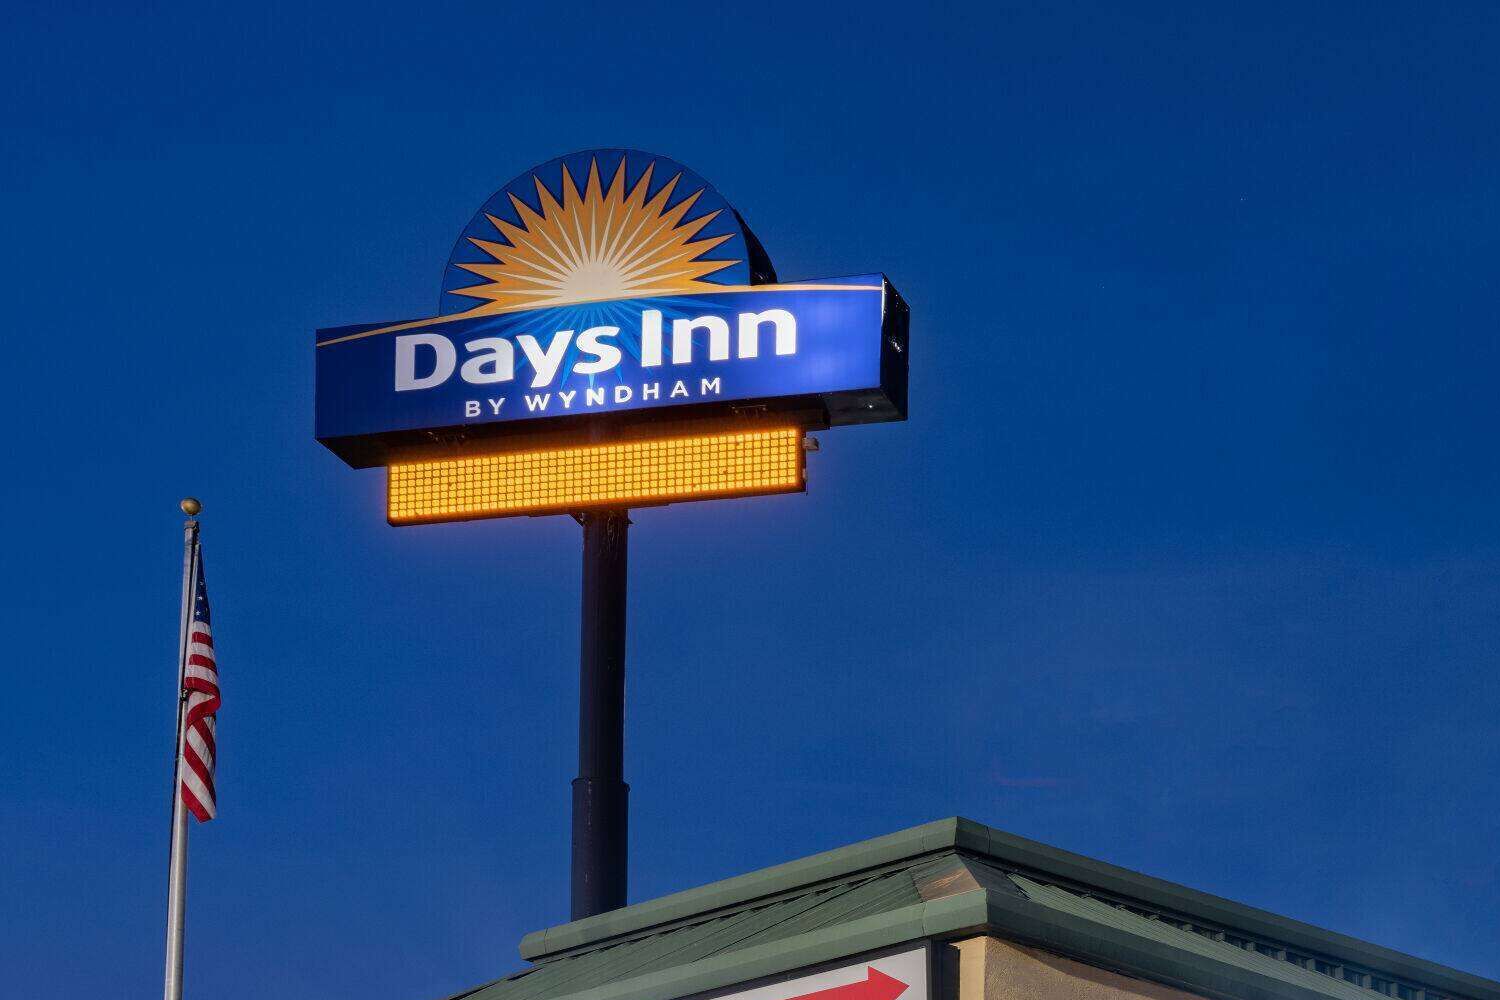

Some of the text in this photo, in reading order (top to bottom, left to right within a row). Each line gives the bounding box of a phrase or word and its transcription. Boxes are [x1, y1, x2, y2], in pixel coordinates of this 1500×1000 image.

[394, 306, 798, 392] Days Inn
[465, 376, 723, 418] BY WYNDHAM
